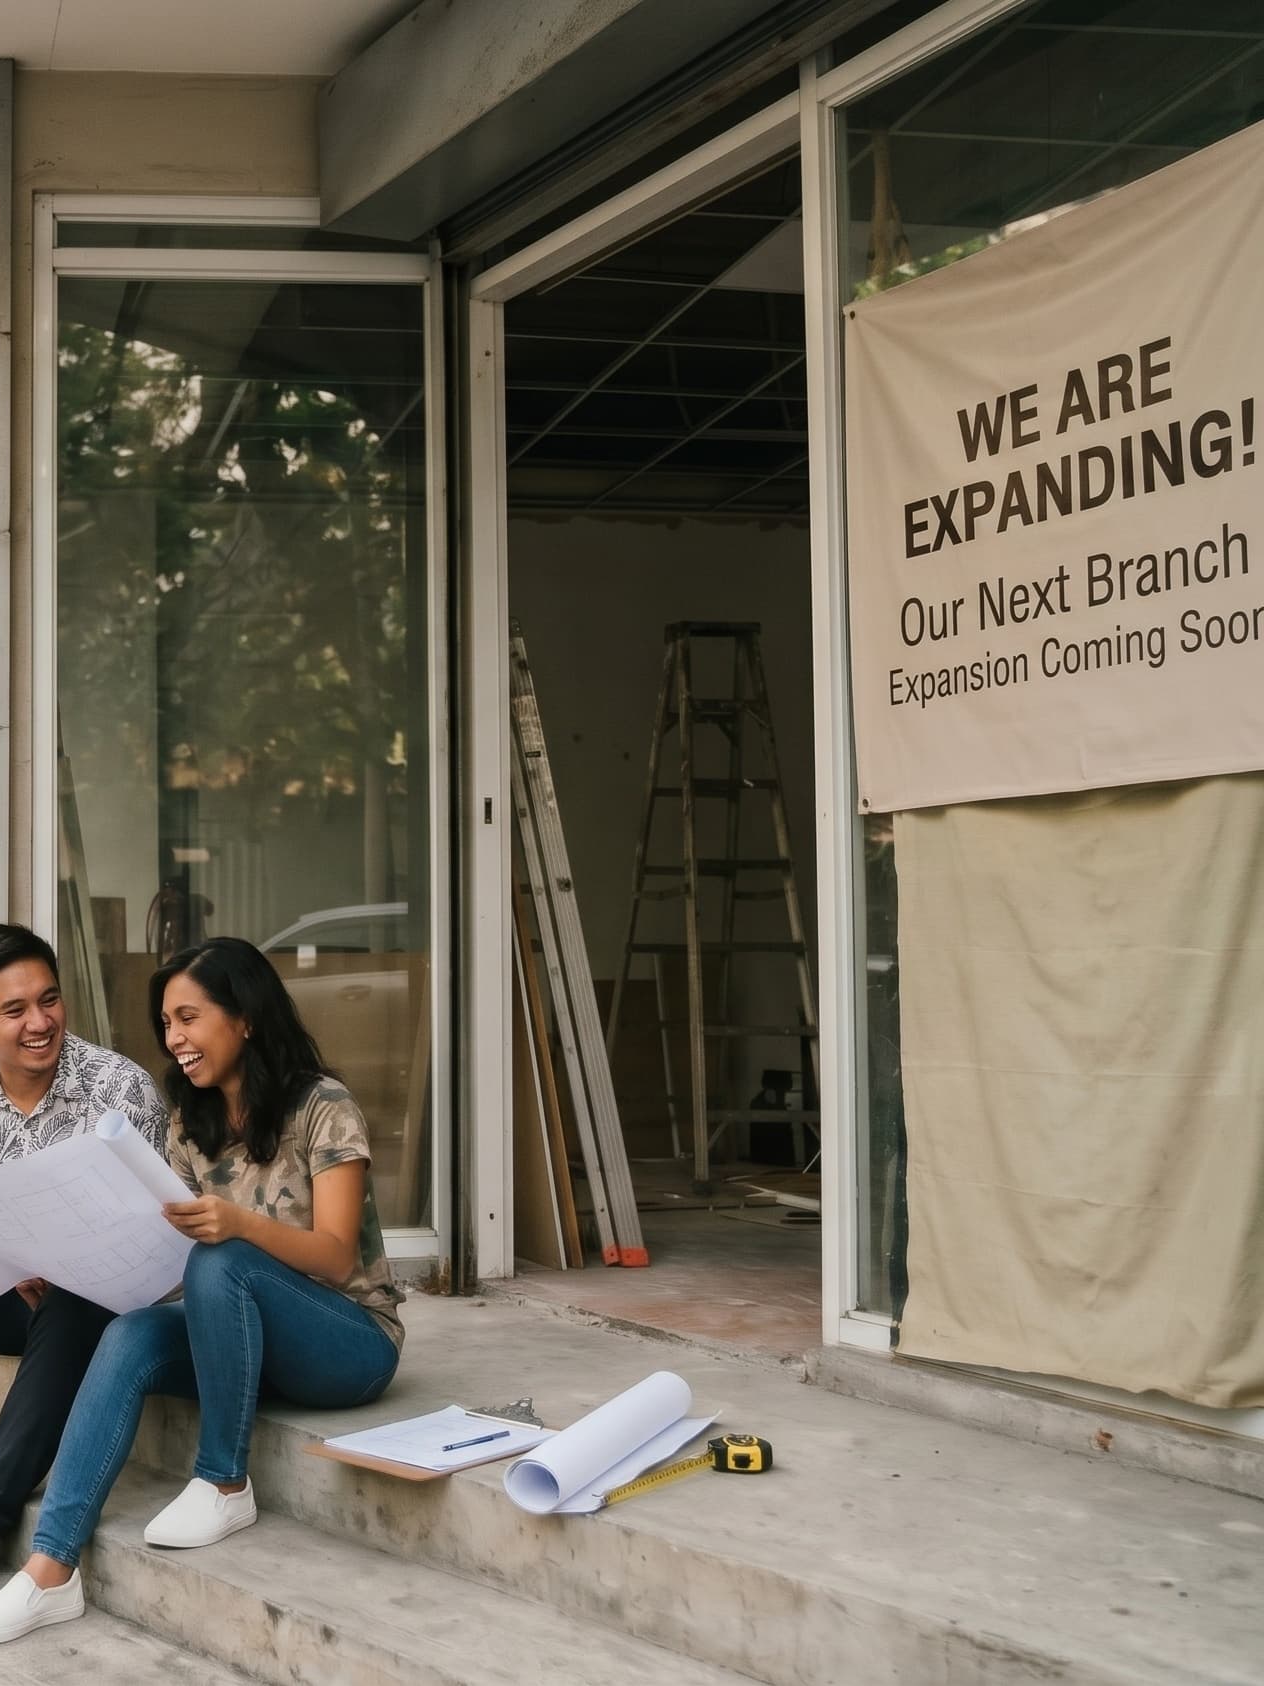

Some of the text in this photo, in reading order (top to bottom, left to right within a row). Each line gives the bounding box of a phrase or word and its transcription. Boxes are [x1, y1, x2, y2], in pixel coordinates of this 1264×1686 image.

[956, 335, 1173, 463] WE ARE
[904, 397, 1255, 559] EXPANDING!
[900, 522, 1249, 647] Our Next Branch
[889, 651, 1028, 709] Expansion
[1041, 624, 1166, 678] Coming
